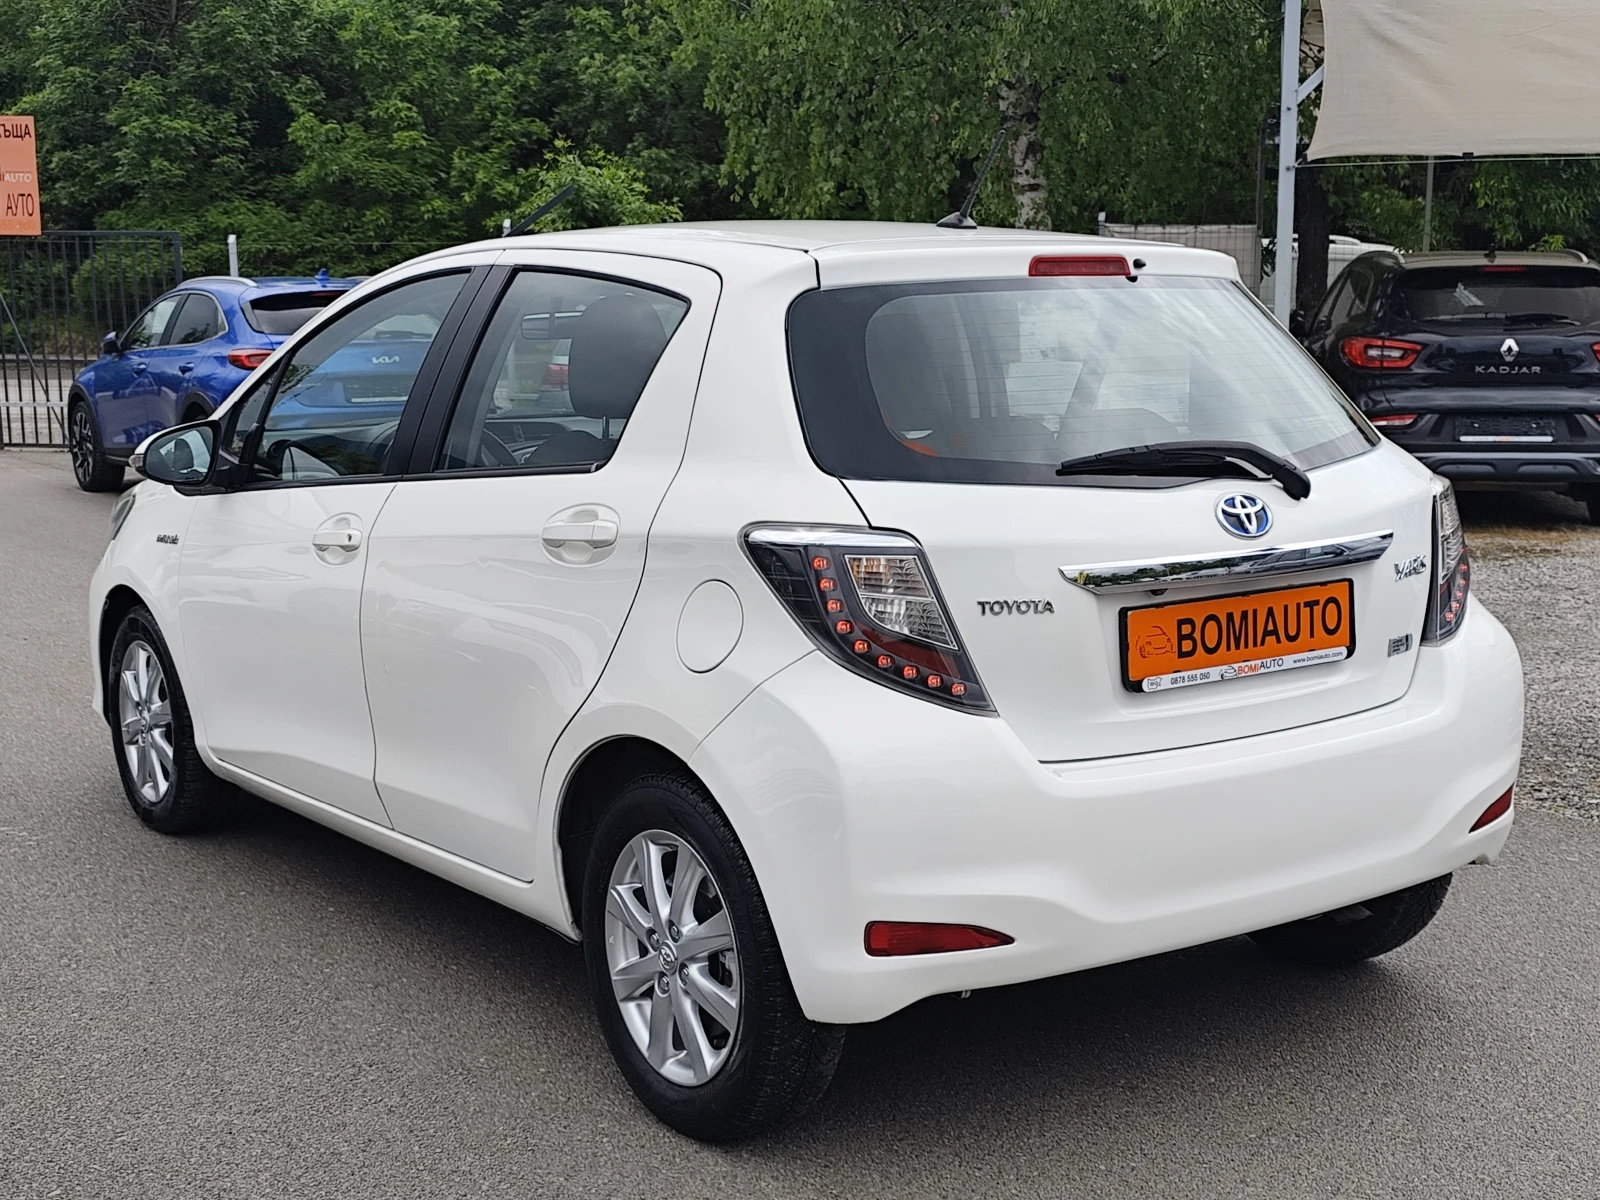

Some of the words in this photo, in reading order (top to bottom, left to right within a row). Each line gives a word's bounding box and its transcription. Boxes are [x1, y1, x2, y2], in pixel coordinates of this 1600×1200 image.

[0, 123, 32, 141] ЪЩА
[0, 172, 32, 183] IAUTO
[1474, 366, 1541, 374] KADJAR
[977, 599, 1055, 617] TOYOTA
[1177, 596, 1343, 660] BOMIAUTO
[1237, 657, 1284, 675] BOMIAUTO
[1292, 651, 1344, 665] www.bomiauto.com
[1170, 676, 1186, 685] 0878
[1187, 673, 1198, 683] 555
[1199, 671, 1211, 681] 050
